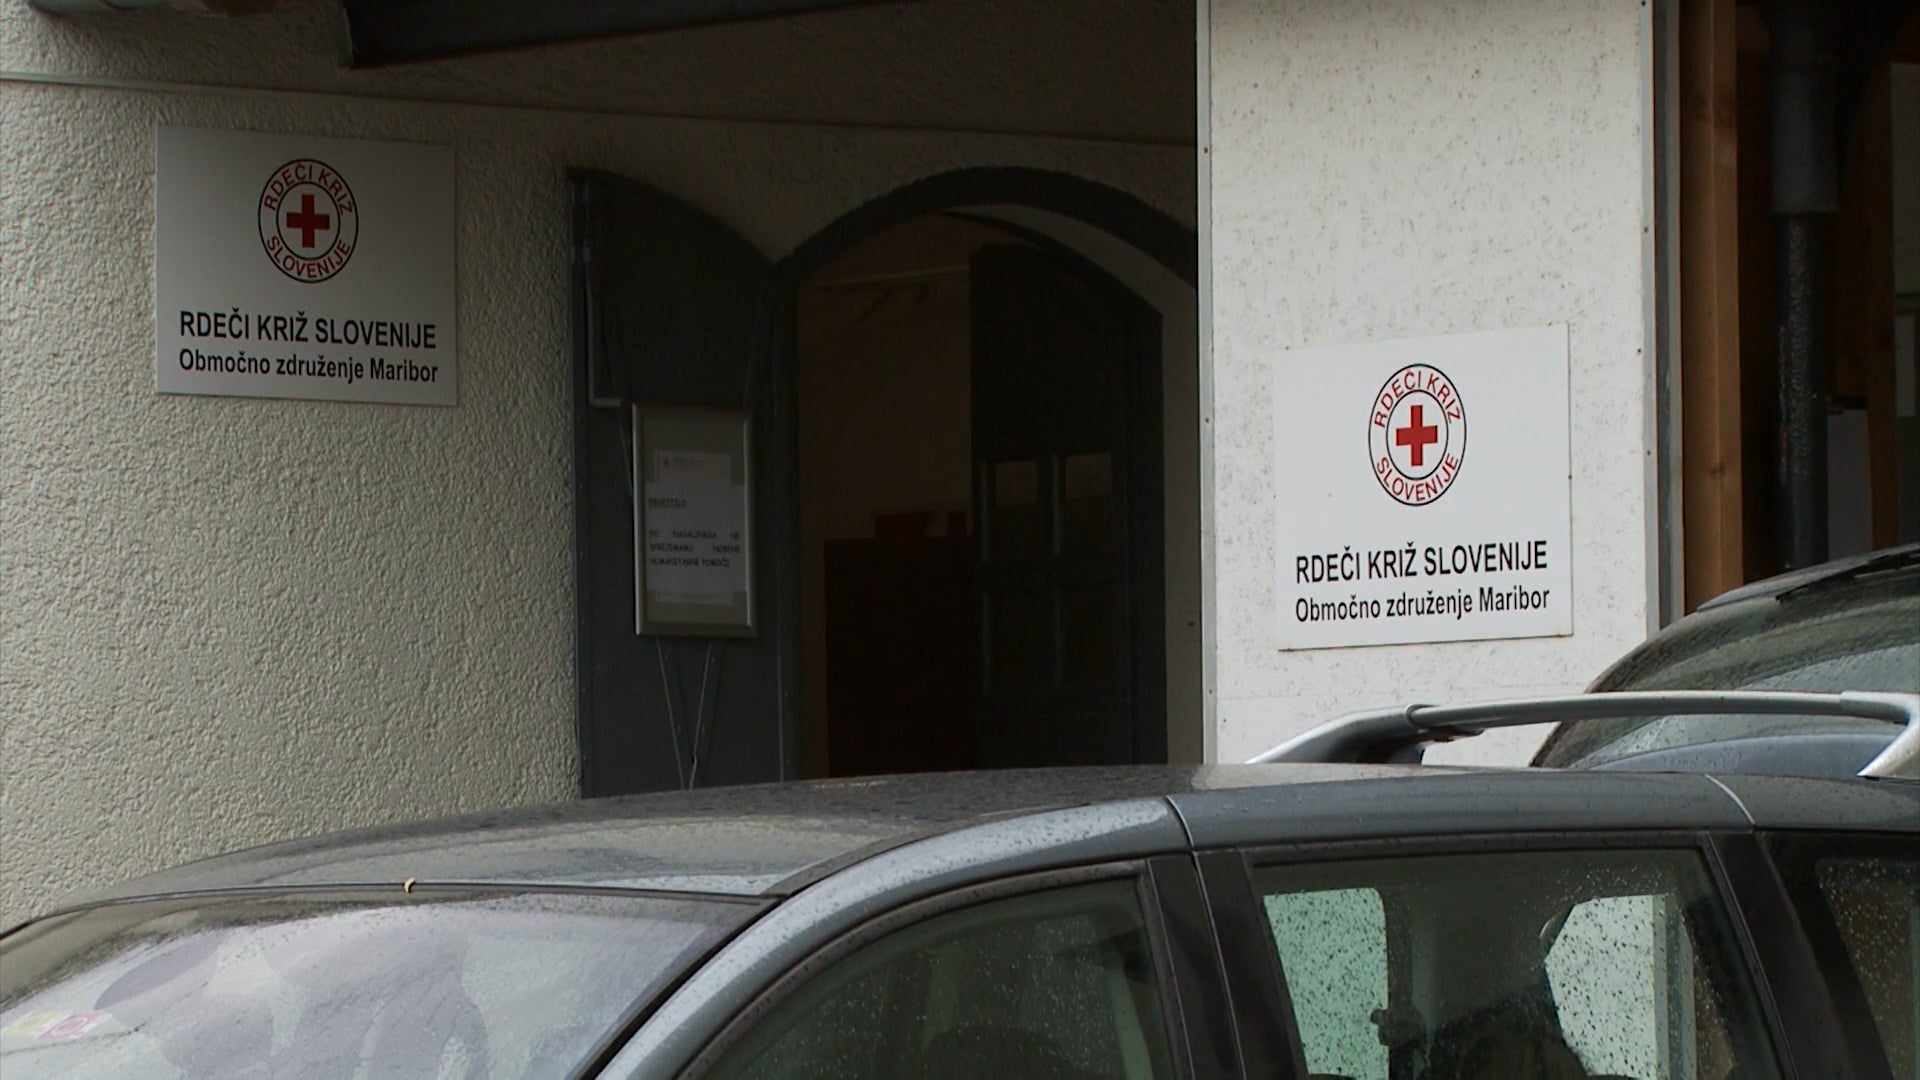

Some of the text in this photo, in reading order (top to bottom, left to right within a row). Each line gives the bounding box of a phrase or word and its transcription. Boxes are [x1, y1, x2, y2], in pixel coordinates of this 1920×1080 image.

[266, 235, 351, 279] SLOVENIJE
[179, 307, 436, 349] RDEČI KRIŽ SLOVENIJE
[179, 348, 439, 384] Območno združenje Maribor
[1376, 453, 1459, 502] SLOVENIJE
[1296, 540, 1548, 584] RDEČI KRIŽ SLOVENIJE
[1295, 585, 1550, 623] Območno združenje Maribor
